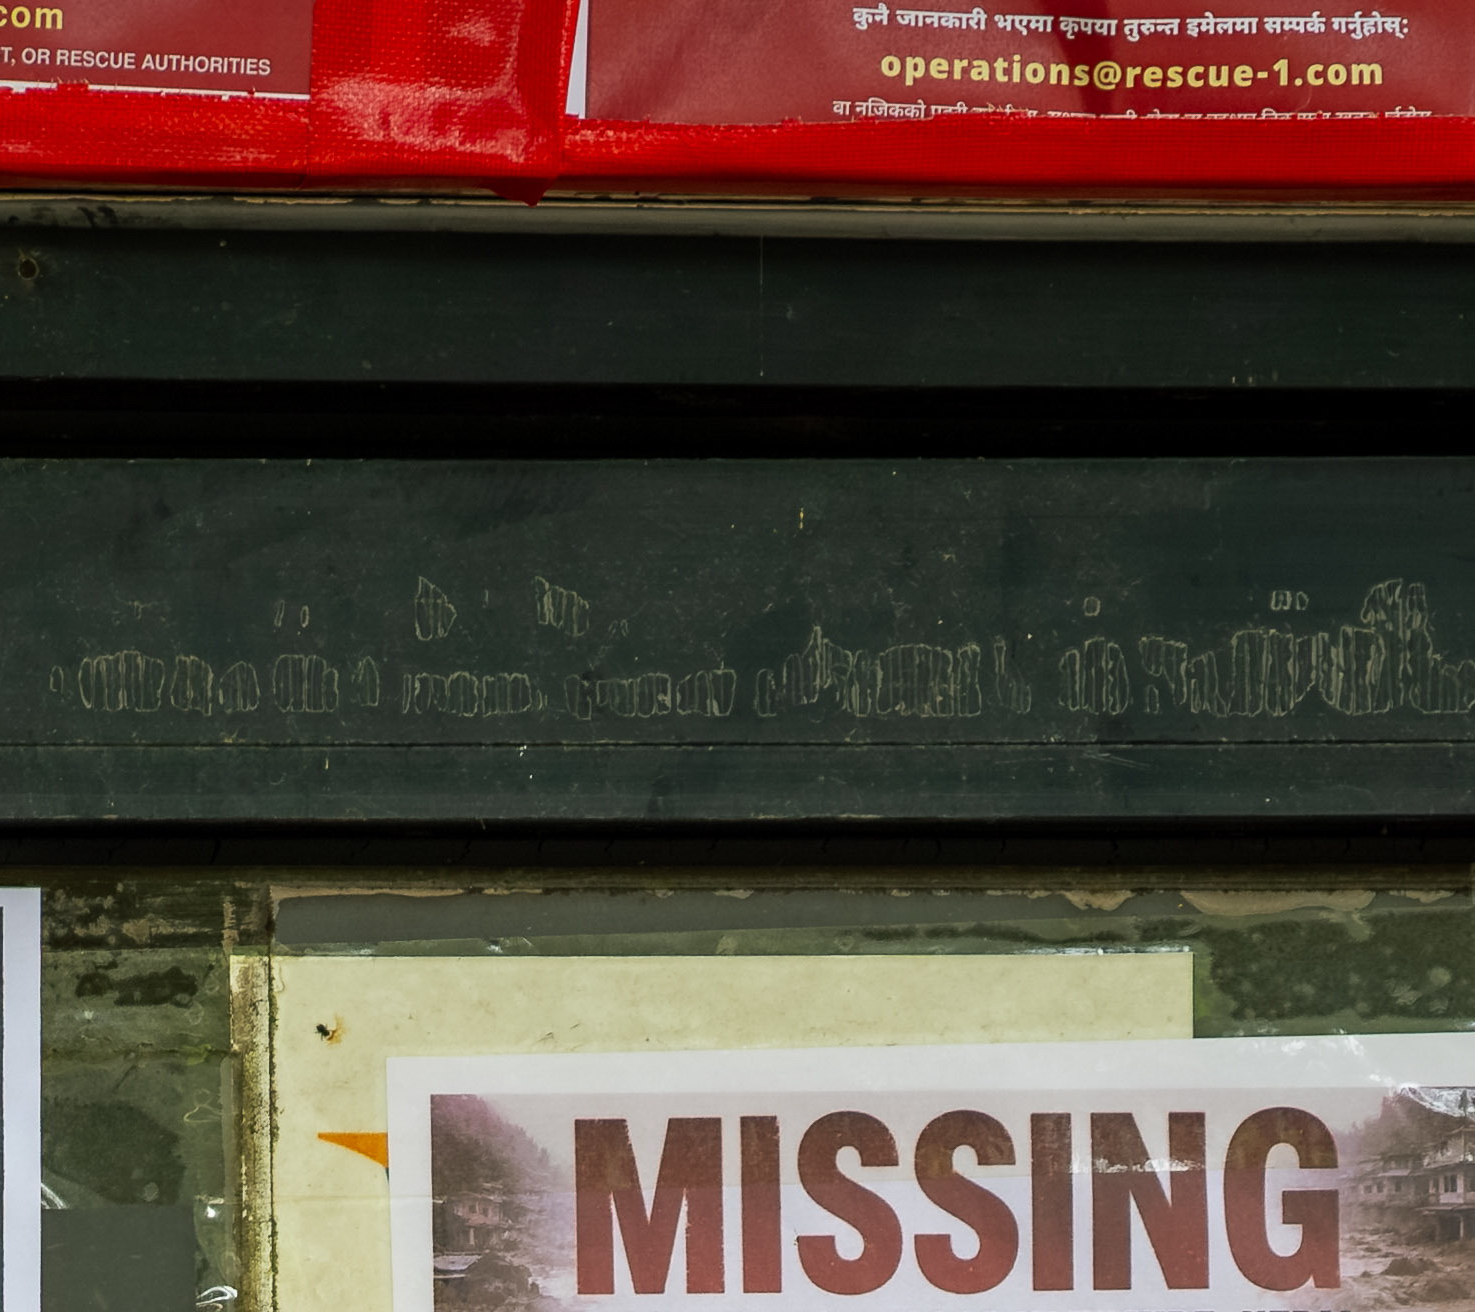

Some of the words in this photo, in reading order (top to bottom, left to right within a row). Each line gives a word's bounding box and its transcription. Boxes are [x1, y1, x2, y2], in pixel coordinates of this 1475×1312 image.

[852, 2, 889, 30] कुनै
[895, 7, 987, 31] जानकारी
[993, 14, 1054, 36] भएमा
[1059, 16, 1117, 39] कृपया
[1123, 17, 1180, 42] तुरुन्त
[1186, 12, 1258, 37] इमेलमा
[1264, 11, 1326, 36] सम्पर्क
[21, 47, 49, 65] OR
[56, 50, 135, 70] RESCUE
[142, 53, 271, 75] AUTHORITIES
[880, 54, 1383, 90] operations@rescue-1.com
[573, 1106, 1342, 1298] MISSING
